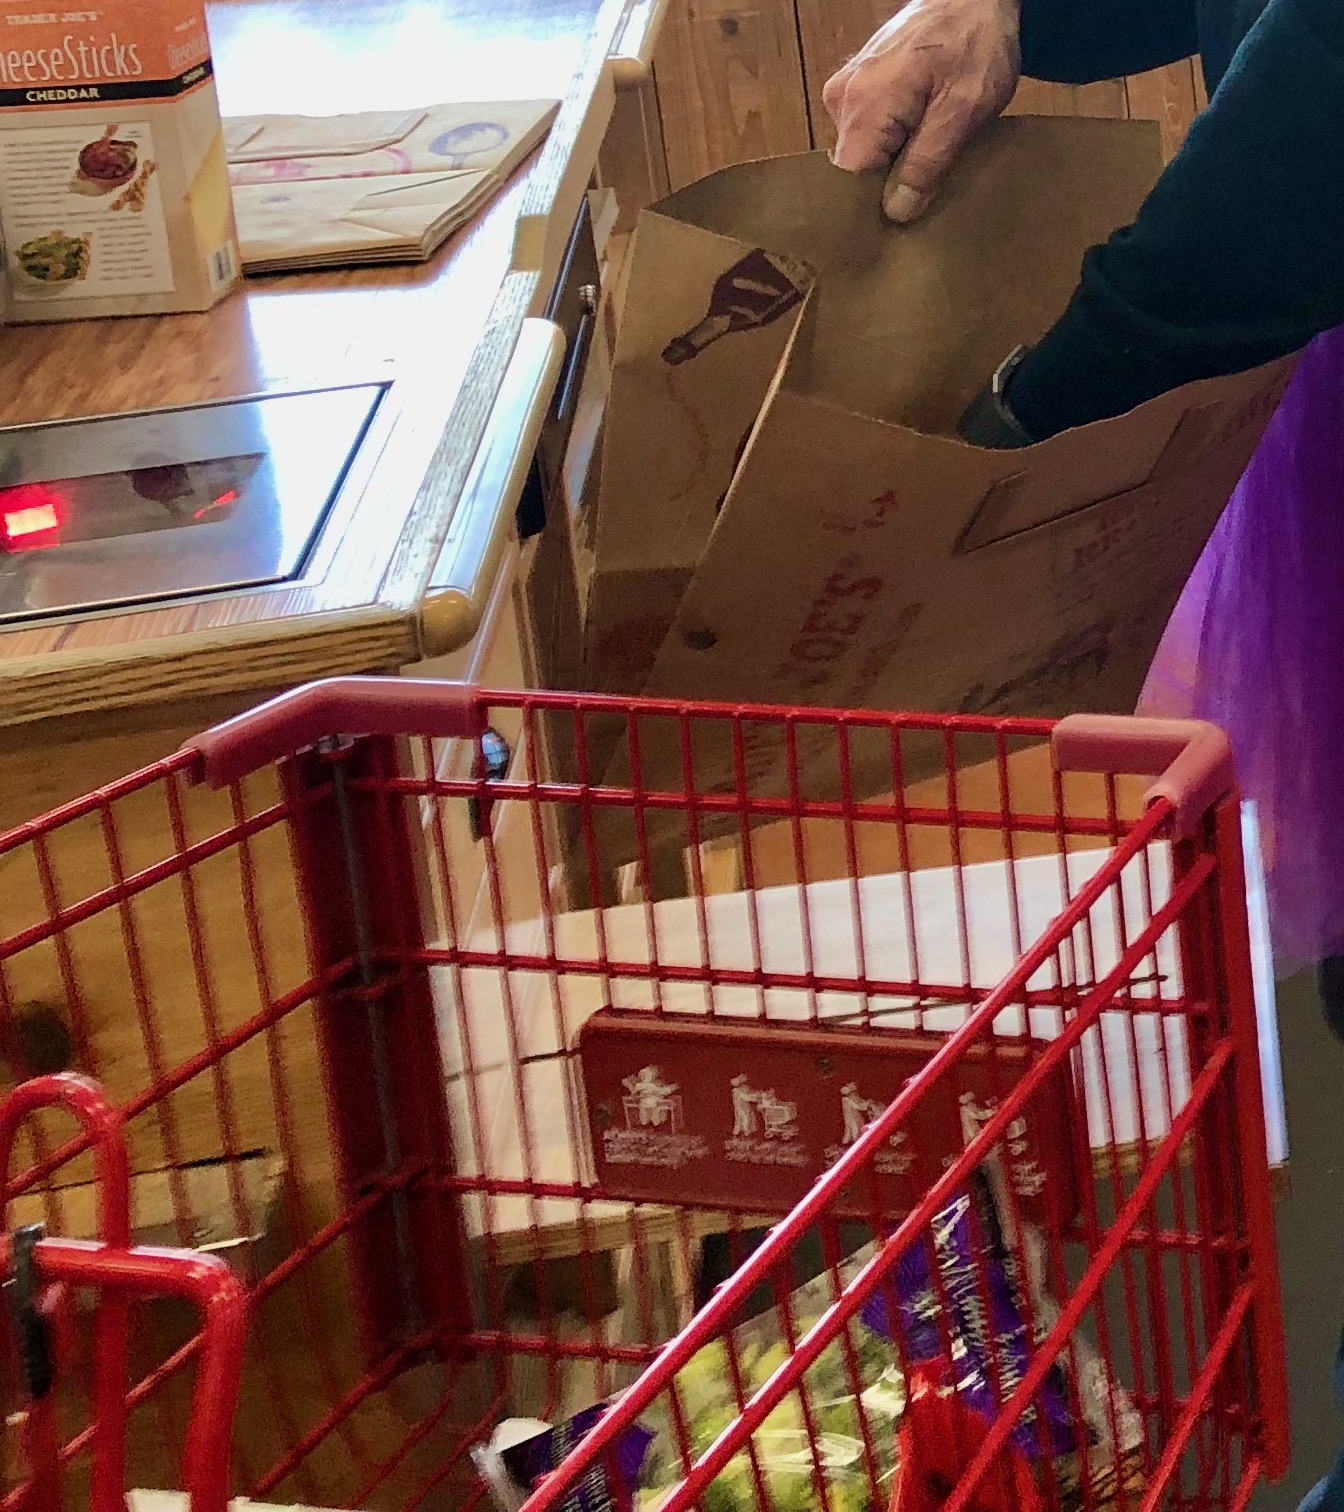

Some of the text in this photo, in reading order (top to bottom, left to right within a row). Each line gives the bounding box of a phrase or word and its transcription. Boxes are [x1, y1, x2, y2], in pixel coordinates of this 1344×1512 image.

[6, 10, 99, 25] TRADER JOE'S
[25, 87, 100, 102] CHEDDAR
